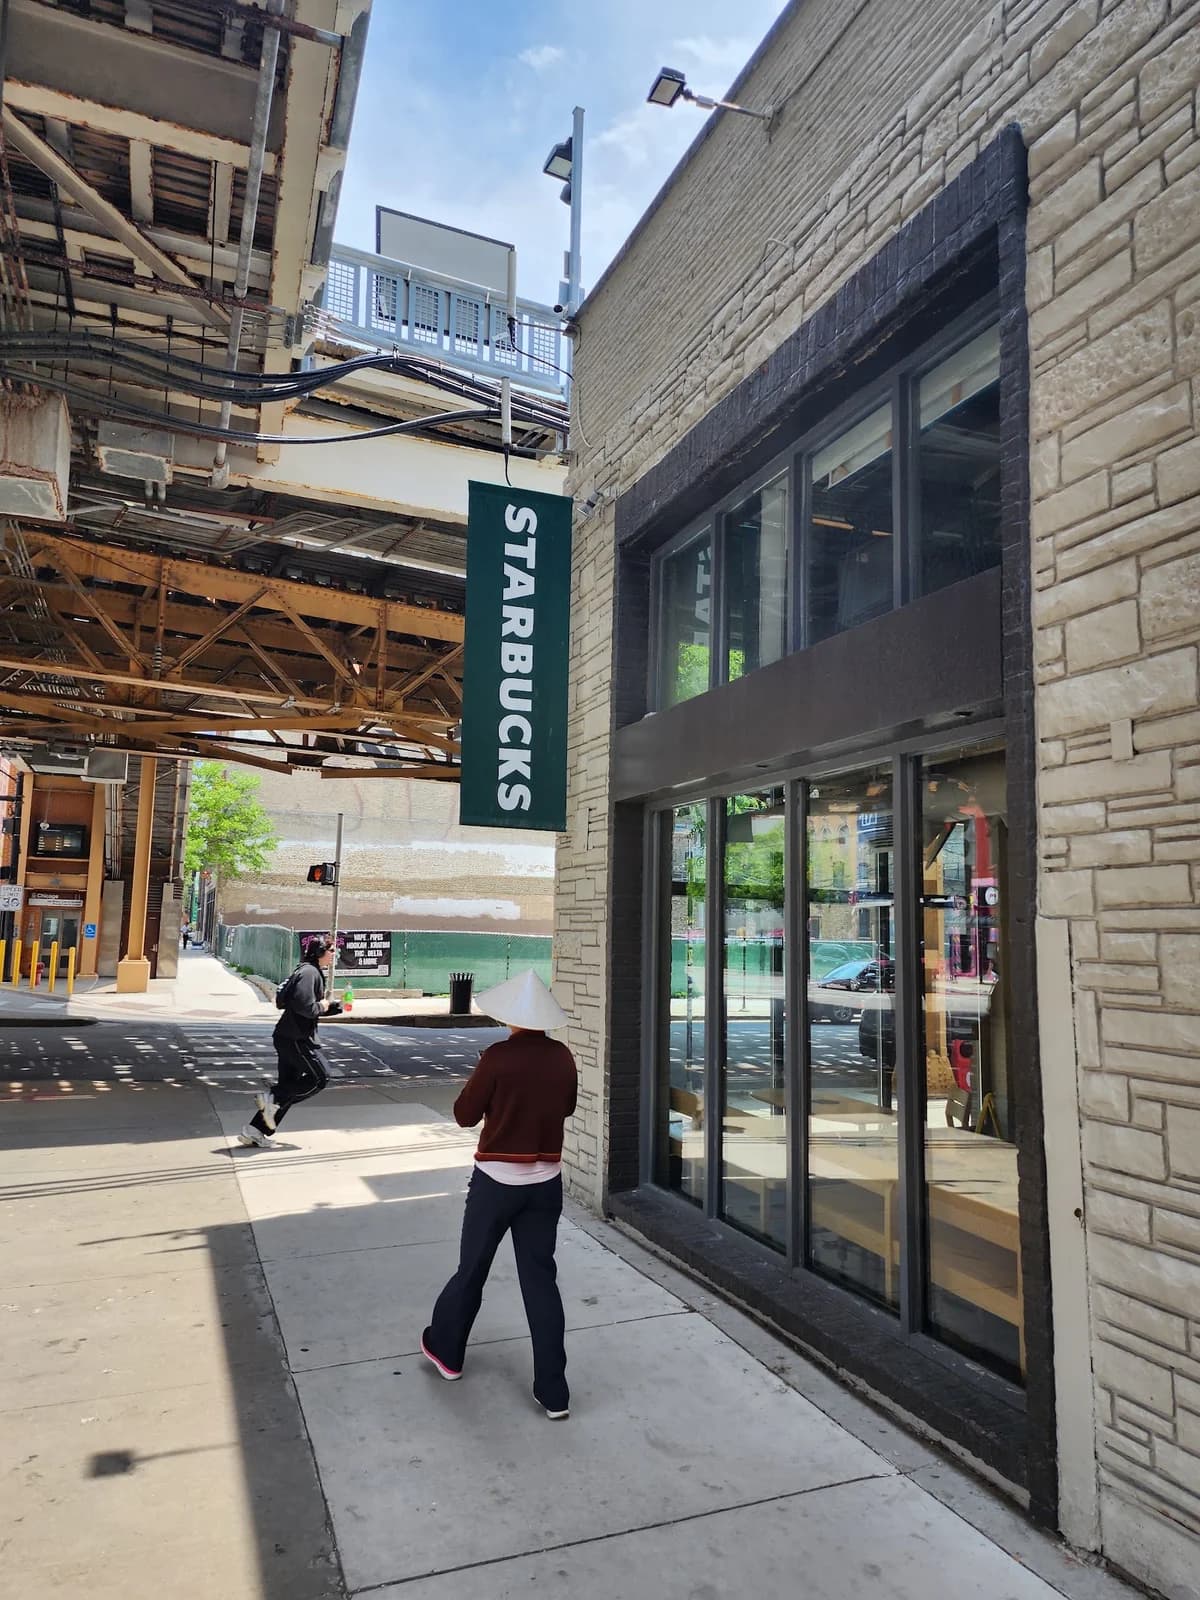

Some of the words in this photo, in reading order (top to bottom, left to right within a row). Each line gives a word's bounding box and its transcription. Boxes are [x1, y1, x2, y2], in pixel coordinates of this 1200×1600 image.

[497, 503, 538, 811] STARBUCKS
[354, 933, 367, 941] VAPE
[370, 933, 383, 941] PIPES
